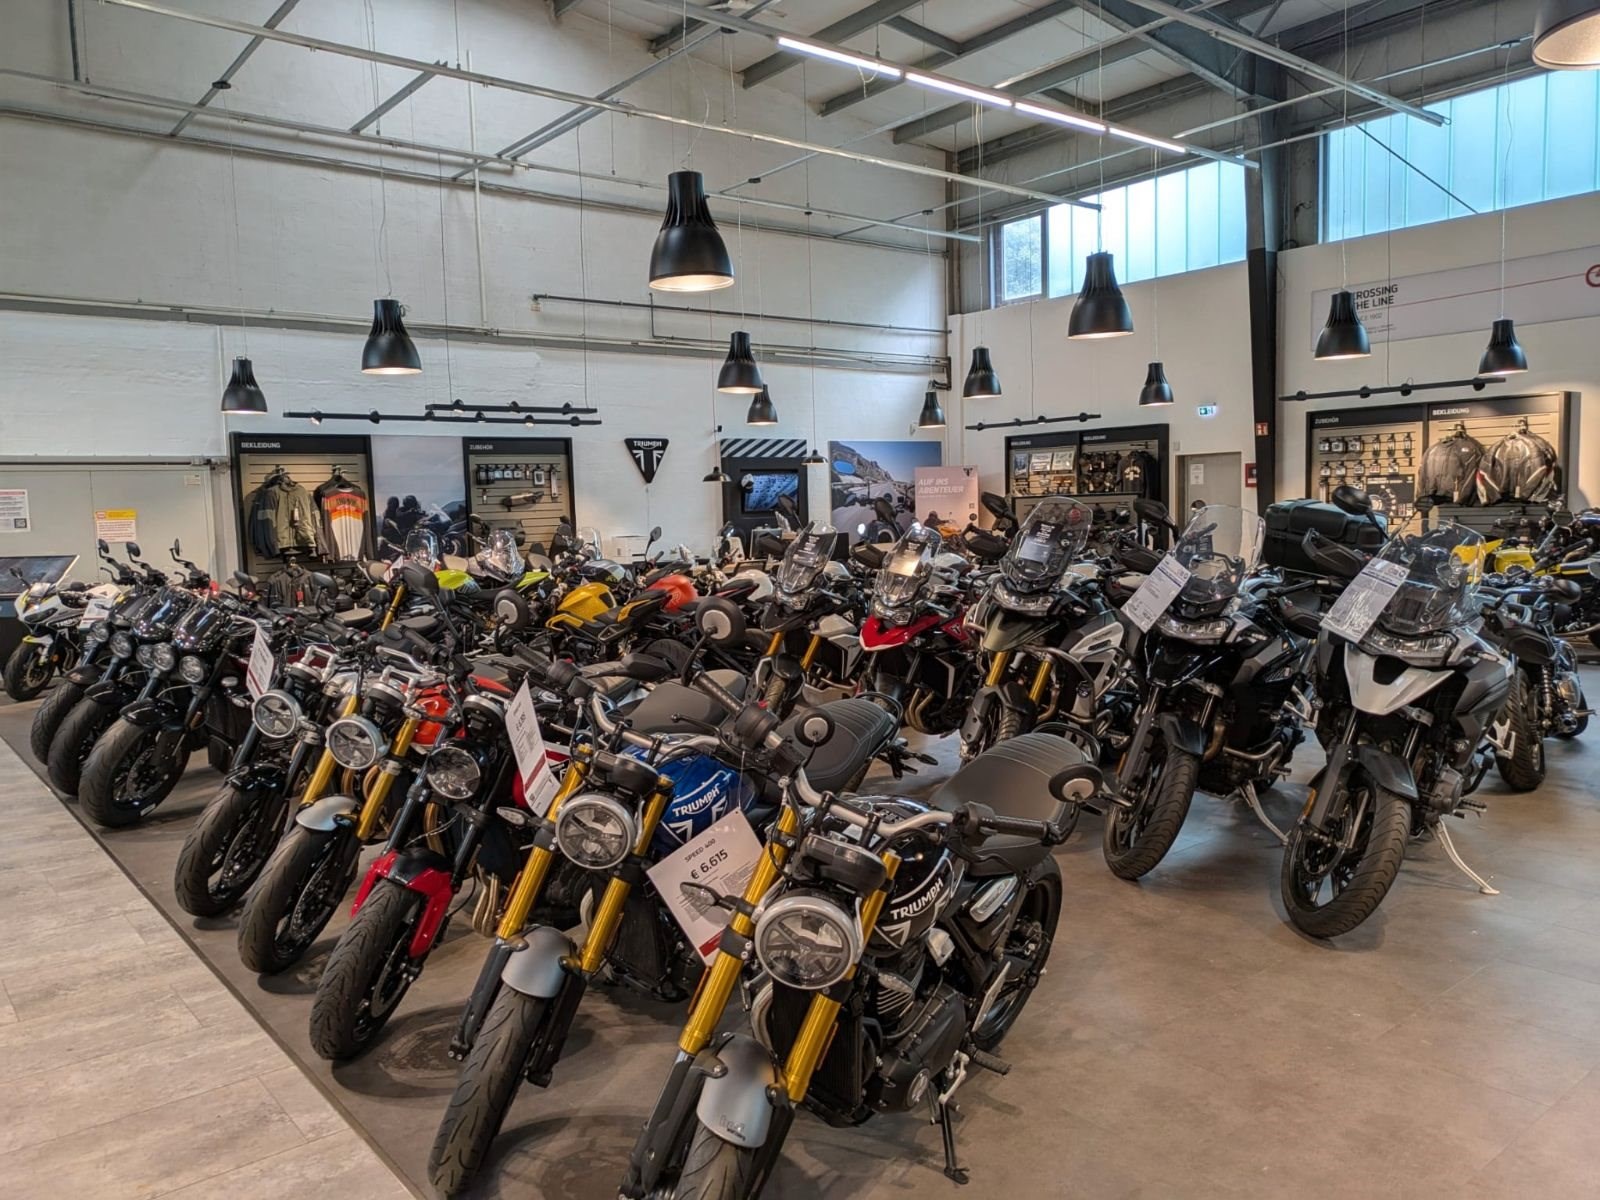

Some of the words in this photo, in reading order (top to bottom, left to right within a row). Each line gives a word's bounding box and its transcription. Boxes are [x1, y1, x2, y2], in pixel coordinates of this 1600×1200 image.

[1355, 284, 1399, 300] ROSSING
[1355, 300, 1370, 310] HE
[1372, 295, 1395, 308] LINE
[1432, 407, 1470, 416] BEKLEIDUNG
[918, 478, 934, 486] AUF
[935, 478, 949, 486] INS
[918, 486, 965, 494] ABENTEUER
[672, 783, 720, 817] TRIUMPH
[684, 847, 704, 863] SPEED
[704, 838, 716, 849] 400
[691, 869, 700, 880] €
[700, 848, 729, 874] 6.615
[890, 877, 944, 920] TRIUMPH
